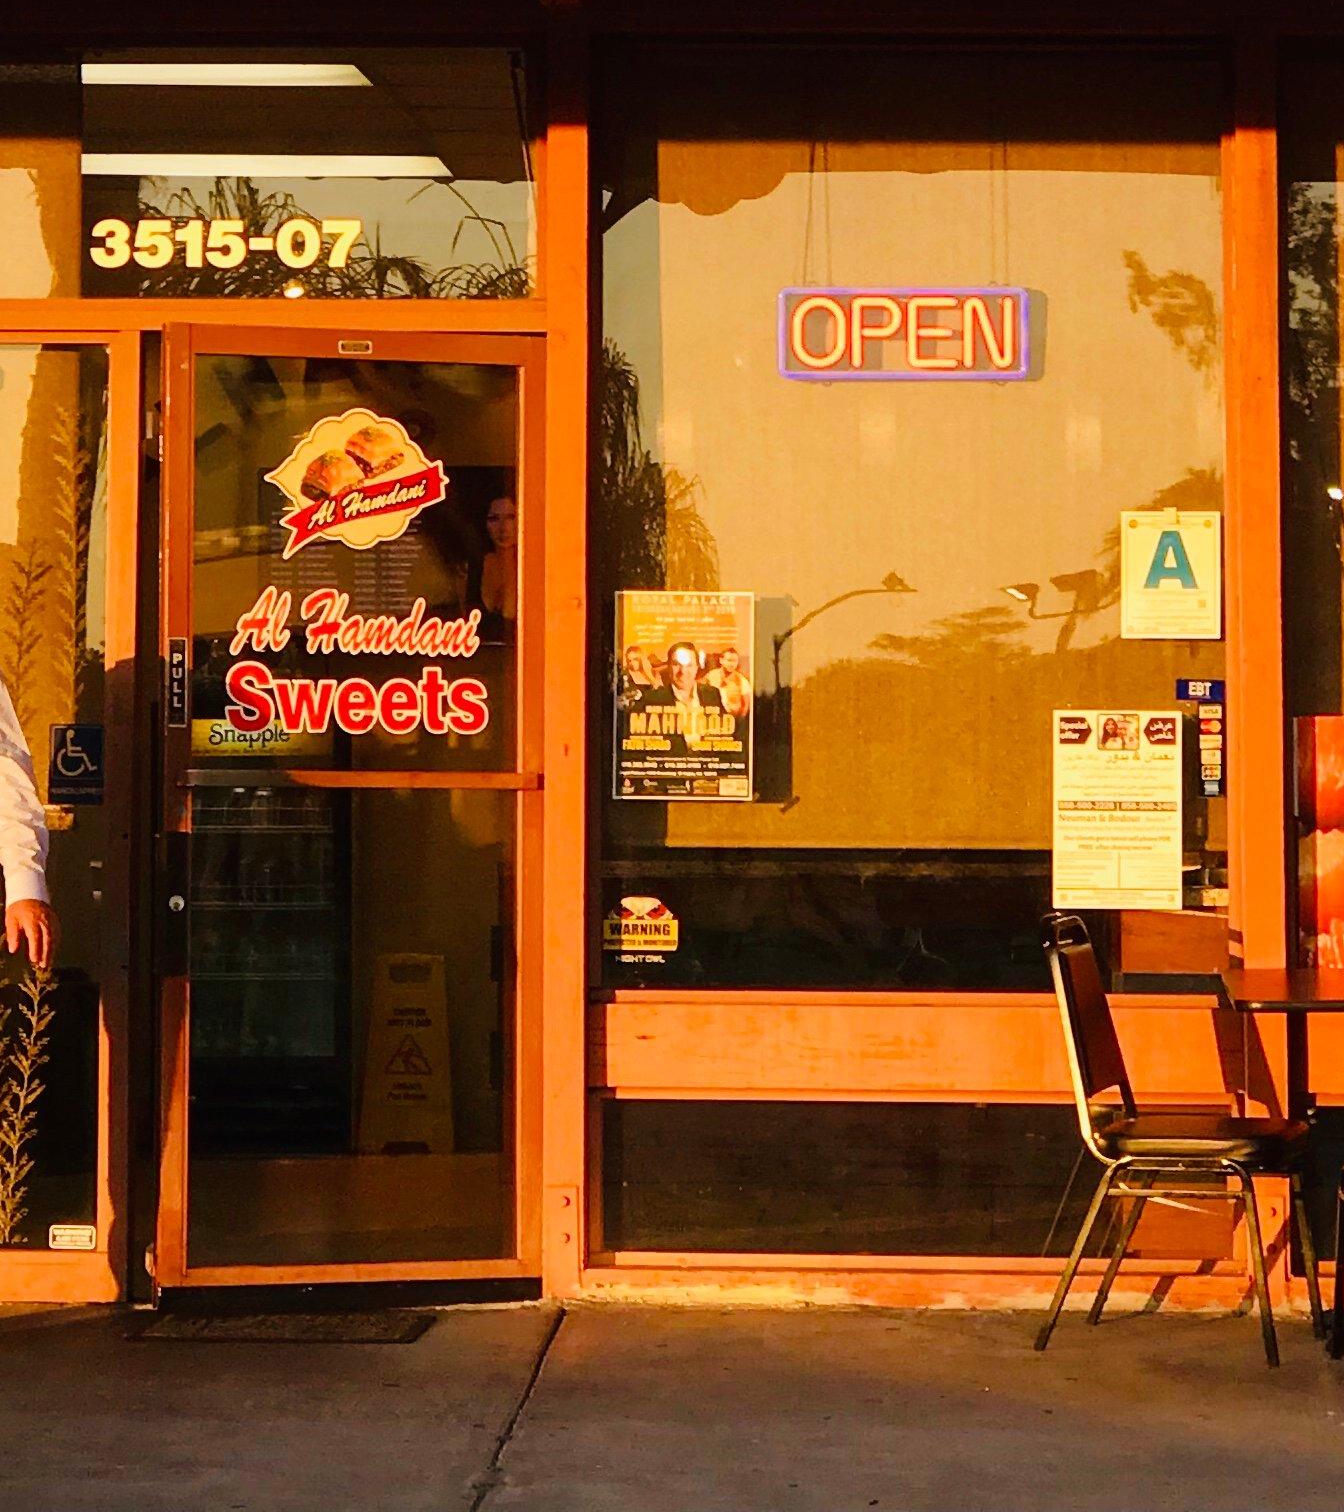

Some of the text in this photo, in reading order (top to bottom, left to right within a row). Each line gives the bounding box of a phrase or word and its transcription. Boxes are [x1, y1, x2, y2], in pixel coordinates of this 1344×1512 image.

[89, 219, 363, 269] 3515-07
[789, 294, 1017, 371] OPEN
[307, 480, 427, 530] Al Hamdani
[1144, 531, 1199, 589] A
[229, 586, 481, 658] Al Hamdani
[172, 653, 183, 708] PULL
[225, 661, 490, 735] Sweets
[1188, 681, 1212, 697] EBT
[609, 923, 671, 936] WARNING
